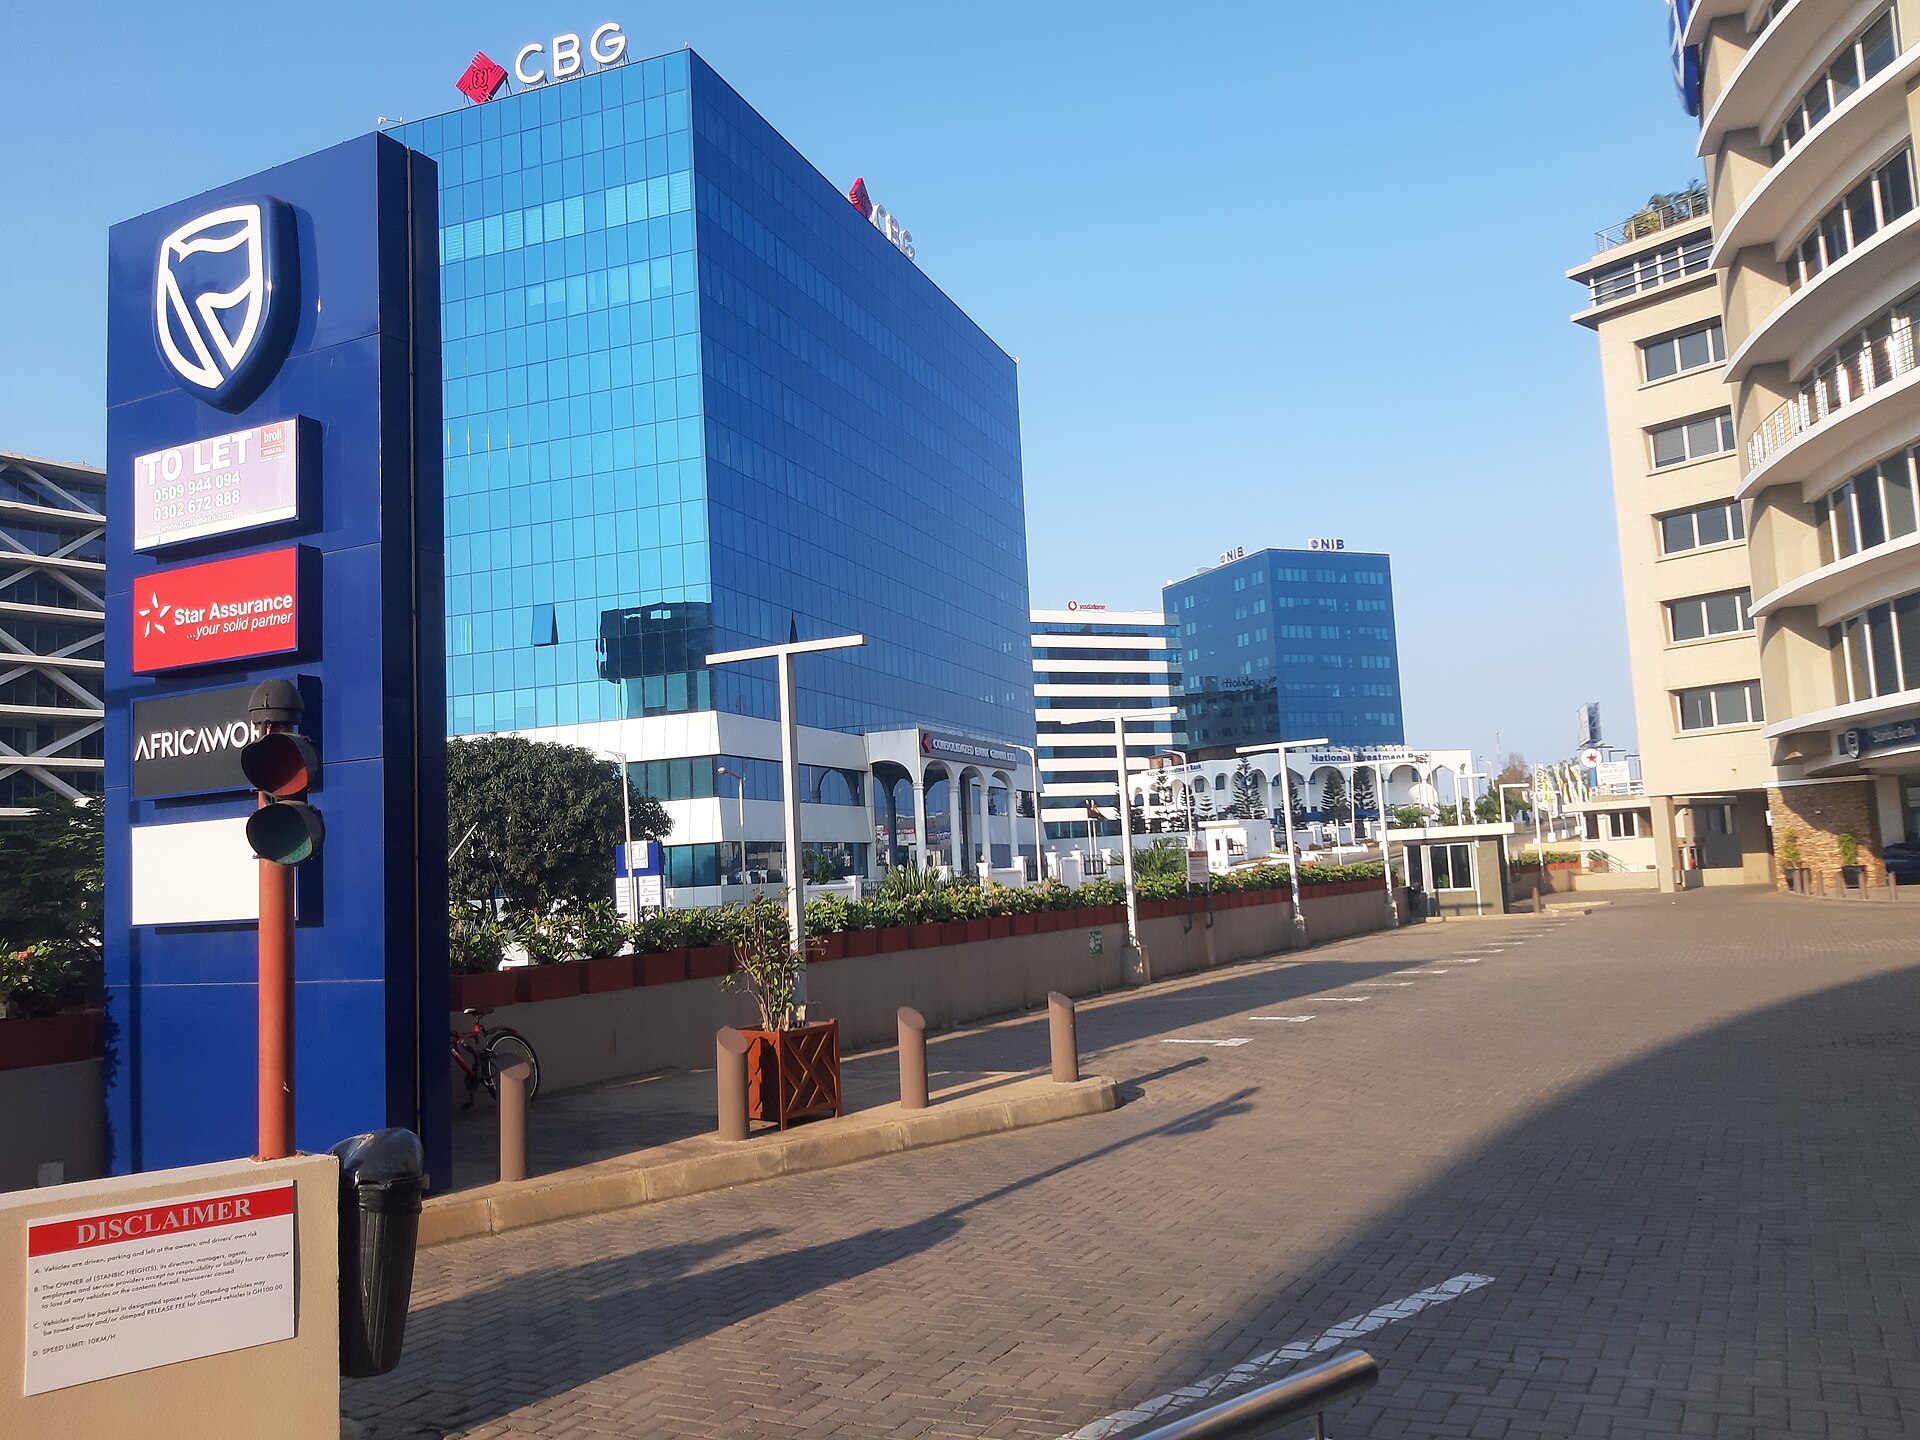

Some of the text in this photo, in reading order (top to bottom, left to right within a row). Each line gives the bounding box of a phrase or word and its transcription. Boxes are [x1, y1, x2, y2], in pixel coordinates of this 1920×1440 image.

[514, 22, 626, 84] CBG
[264, 428, 282, 443] broll
[142, 430, 253, 486] TO LET
[153, 470, 241, 503] 0509 944 094
[153, 489, 241, 522] 0302 672 888
[160, 510, 235, 533] www.brollghana.com
[1226, 546, 1244, 562] NIB
[1320, 539, 1345, 550] NIB
[174, 594, 293, 626] Star Assurance
[186, 612, 294, 641] ...your solid partner
[1898, 724, 1917, 738] Bank
[932, 739, 974, 756] CONSOLIDATED
[974, 746, 989, 758] BANK
[1311, 754, 1350, 762] National
[76, 1199, 252, 1245] DISCLAIMER
[44, 1262, 70, 1272] Vehicles
[84, 1257, 106, 1266] driven,
[107, 1254, 131, 1262] parking
[199, 1238, 210, 1246] and
[42, 1290, 77, 1300] employees
[93, 1282, 114, 1290] service
[116, 1277, 144, 1287] providers
[146, 1272, 165, 1280] accept
[176, 1264, 214, 1275] responsibility
[223, 1258, 244, 1267] liability
[266, 1251, 289, 1259] damage
[56, 1278, 83, 1288] OWNER
[72, 1297, 85, 1305] any
[86, 1292, 110, 1301] vehicles
[132, 1284, 156, 1292] contents
[182, 1273, 213, 1282] howsoever
[43, 1318, 69, 1327] Vehicles
[71, 1314, 86, 1322] must
[97, 1307, 119, 1317] parked
[128, 1299, 161, 1310] designated
[163, 1296, 183, 1304] spaces
[200, 1287, 229, 1296] Offending
[231, 1282, 252, 1290] vehicles
[54, 1325, 74, 1334] towed
[76, 1321, 93, 1329] away
[95, 1317, 118, 1326] and/or
[119, 1311, 145, 1320] clamped
[147, 1305, 173, 1315] RELEASE
[197, 1296, 222, 1304] clamped
[223, 1292, 245, 1300] vehicles
[42, 1345, 64, 1355] SPEED
[88, 1334, 116, 1344] 10KM/H
